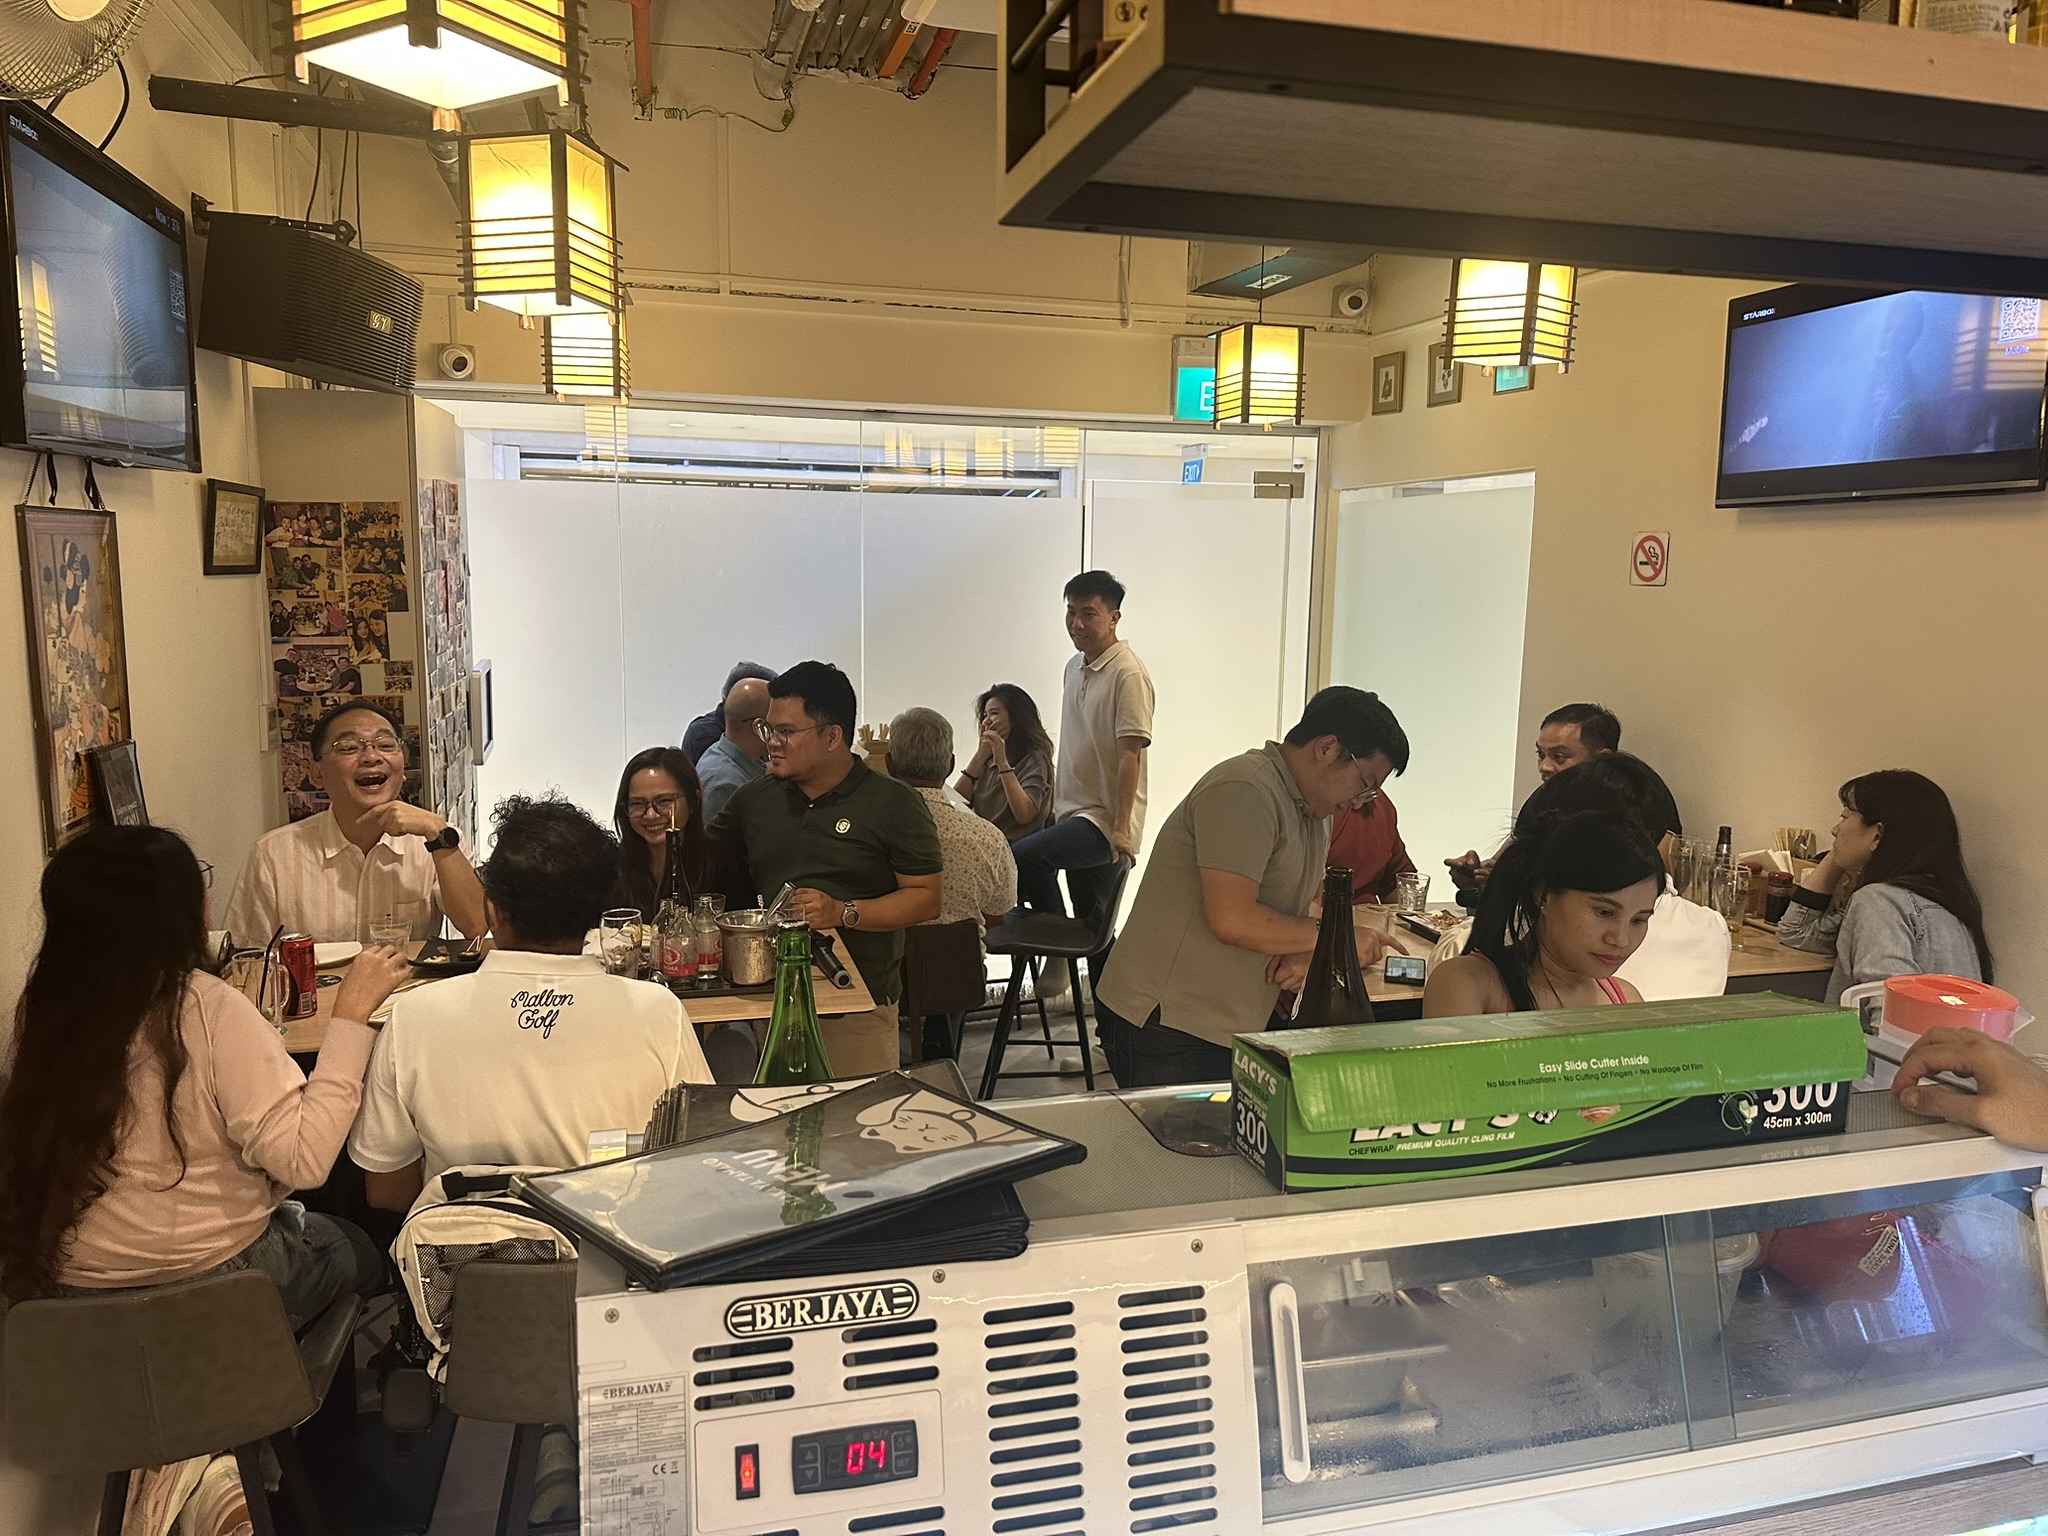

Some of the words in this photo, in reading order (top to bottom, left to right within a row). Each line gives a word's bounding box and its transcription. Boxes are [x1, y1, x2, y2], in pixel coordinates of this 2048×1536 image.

[1184, 463, 1197, 481] EXIT
[518, 1009, 560, 1039] Golf
[1234, 1048, 1277, 1095] LACY'S
[1498, 1079, 1516, 1087] More
[1518, 1076, 1556, 1086] Frustrations
[1564, 1074, 1574, 1082] No
[1575, 1073, 1599, 1081] Cutting
[1601, 1071, 1609, 1079] Of
[1610, 1070, 1633, 1079] Fingers
[1651, 1066, 1680, 1074] Wastage
[1540, 1063, 1562, 1073] Easy
[1565, 1060, 1588, 1071] Slide
[1590, 1057, 1619, 1068] Cutter
[1621, 1055, 1649, 1066] Inside
[1763, 1082, 1838, 1113] 300
[1236, 1102, 1268, 1155] 300
[1763, 1116, 1792, 1129] 45cm
[1795, 1115, 1801, 1126] x
[1804, 1111, 1832, 1125] 300m
[1349, 1145, 1394, 1156] CHEFWRAP
[1396, 1140, 1433, 1151] PREMIUM
[1435, 1136, 1469, 1147] QUALITY
[1471, 1133, 1495, 1143] CLING
[1497, 1131, 1515, 1140] FILM
[754, 1289, 891, 1331] BERJAYA
[609, 1382, 664, 1398] BERJAYA
[847, 1440, 886, 1474] 04
